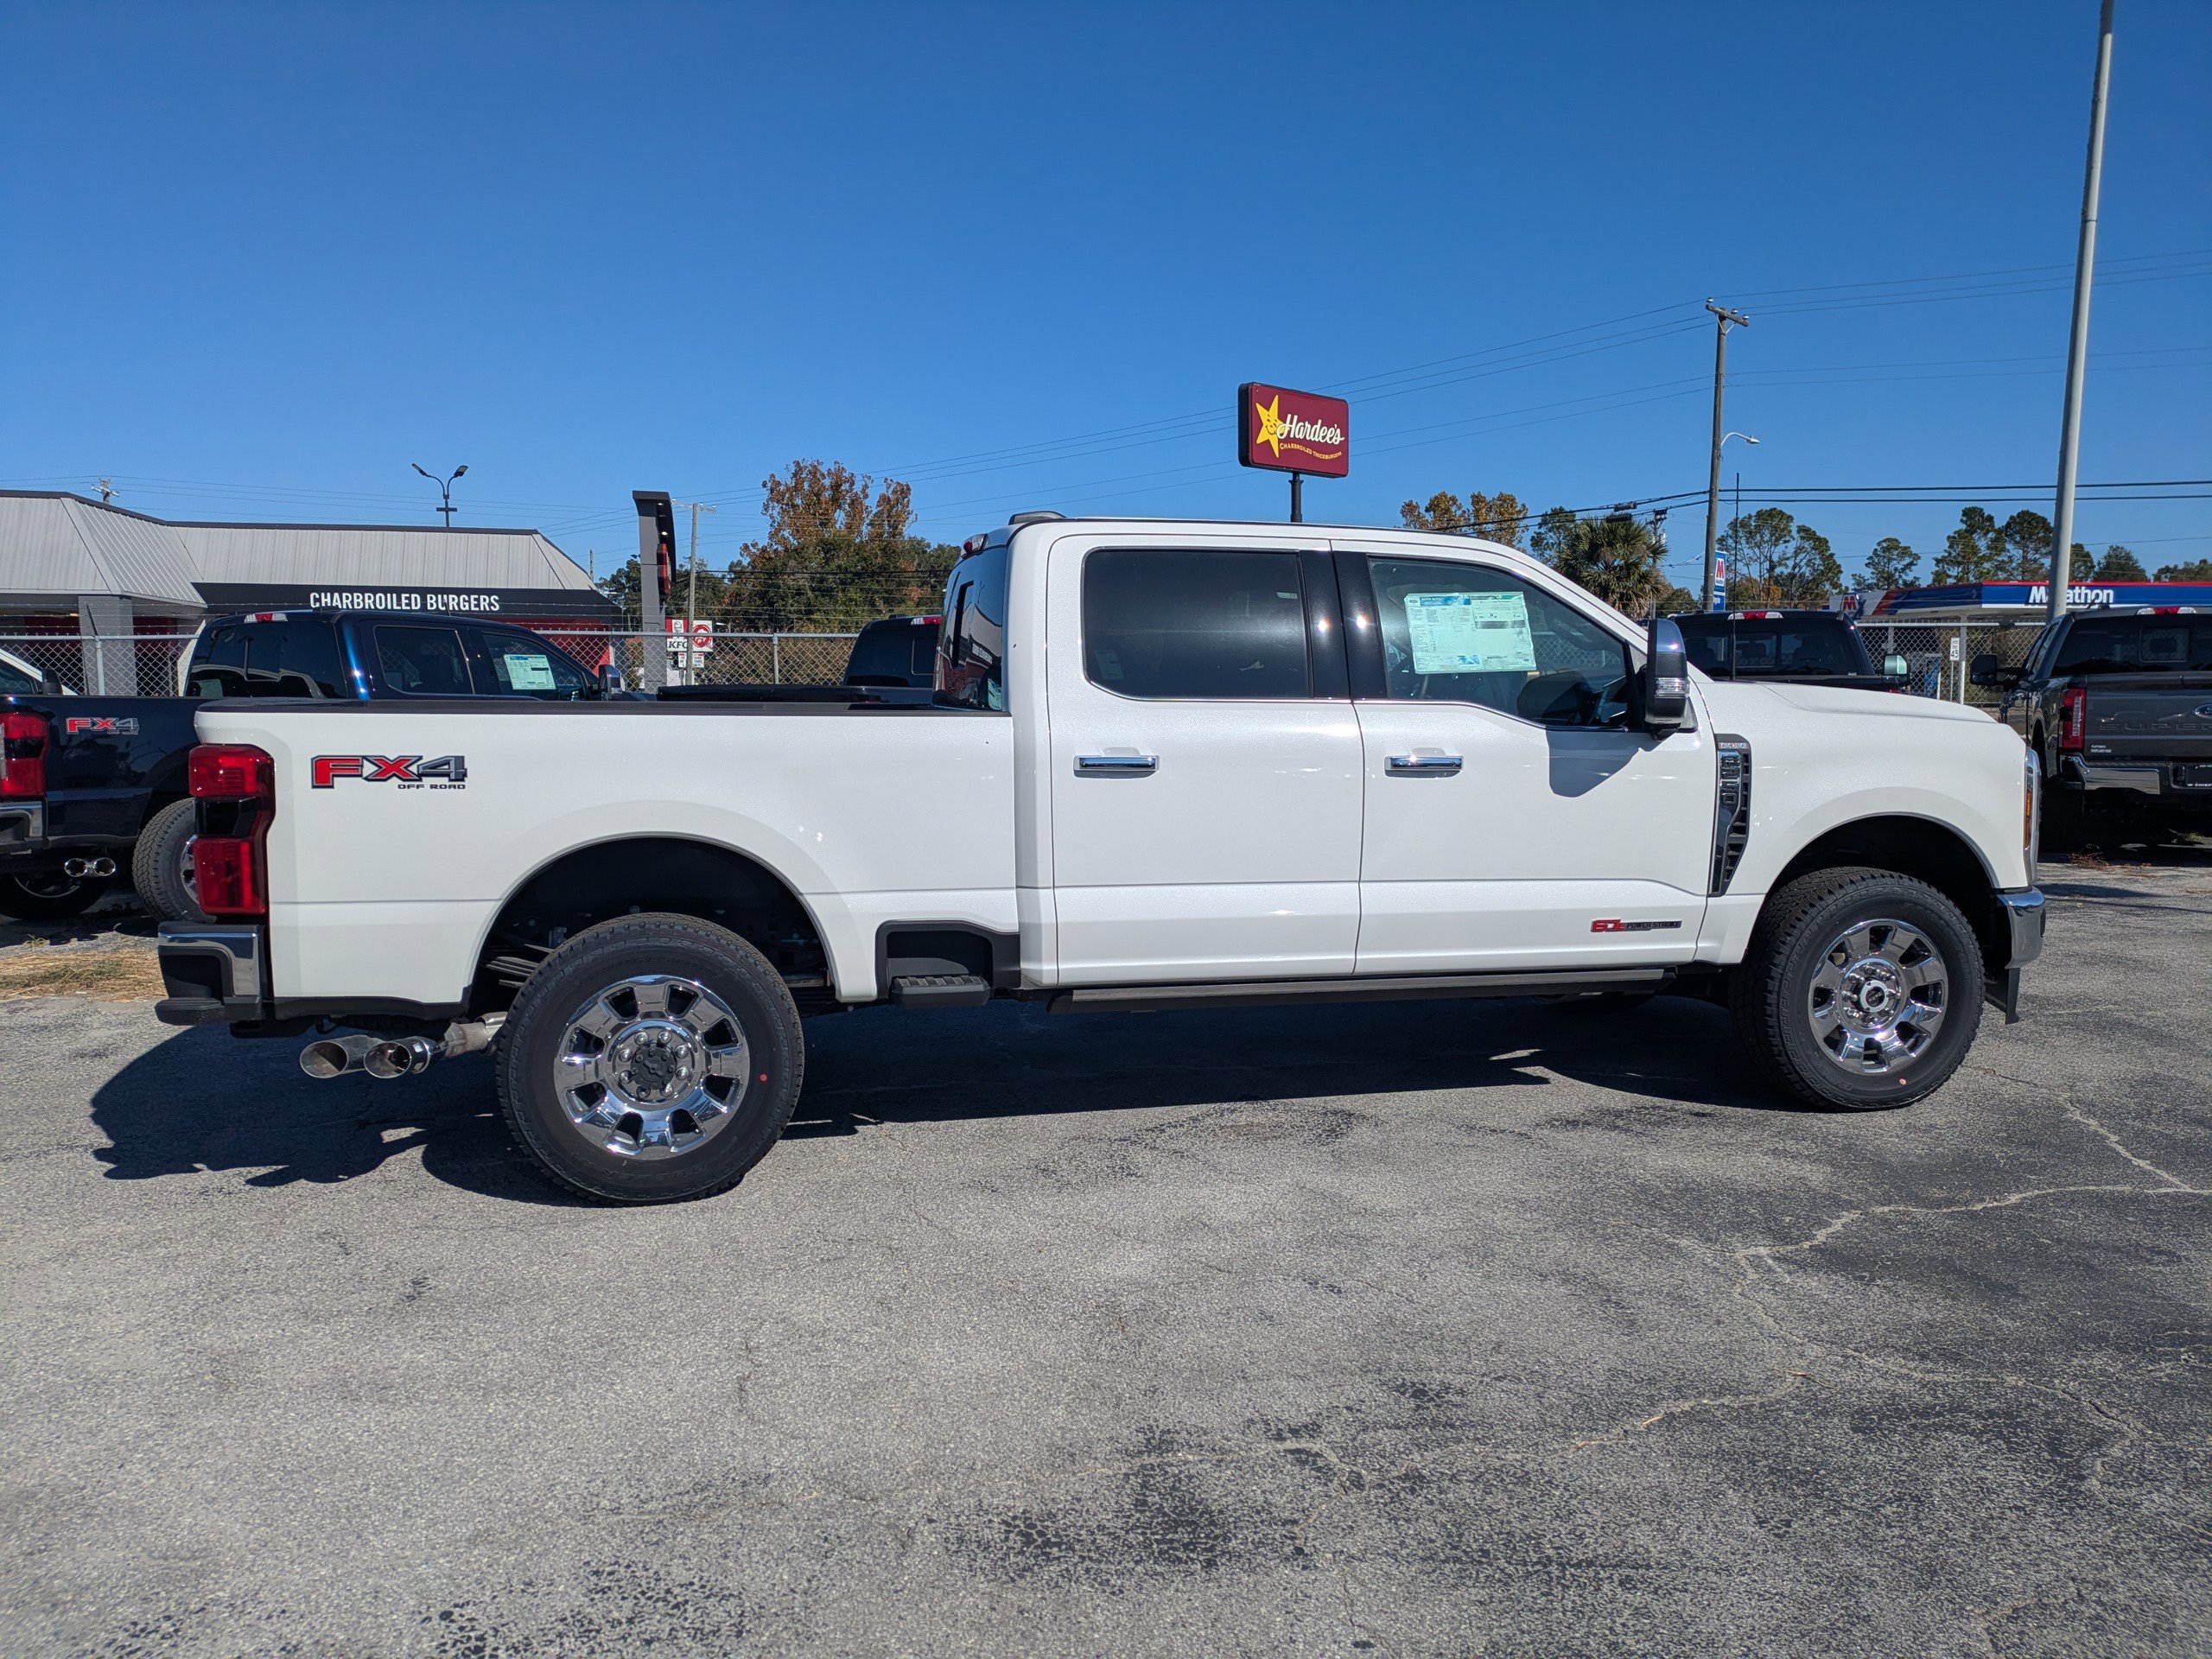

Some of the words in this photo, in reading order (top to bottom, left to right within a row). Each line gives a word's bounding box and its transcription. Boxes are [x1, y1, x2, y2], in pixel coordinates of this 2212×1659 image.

[1276, 414, 1345, 445] Hardee's
[1280, 443, 1313, 455] CHARBROILED
[1313, 451, 1343, 460] THICKBURGERS
[309, 592, 421, 610] CHARBROILED
[427, 594, 500, 612] BURGERS
[2029, 586, 2113, 604] Mathon
[1951, 650, 1959, 658] 45
[66, 717, 139, 734] FX4
[311, 755, 467, 789] FX4
